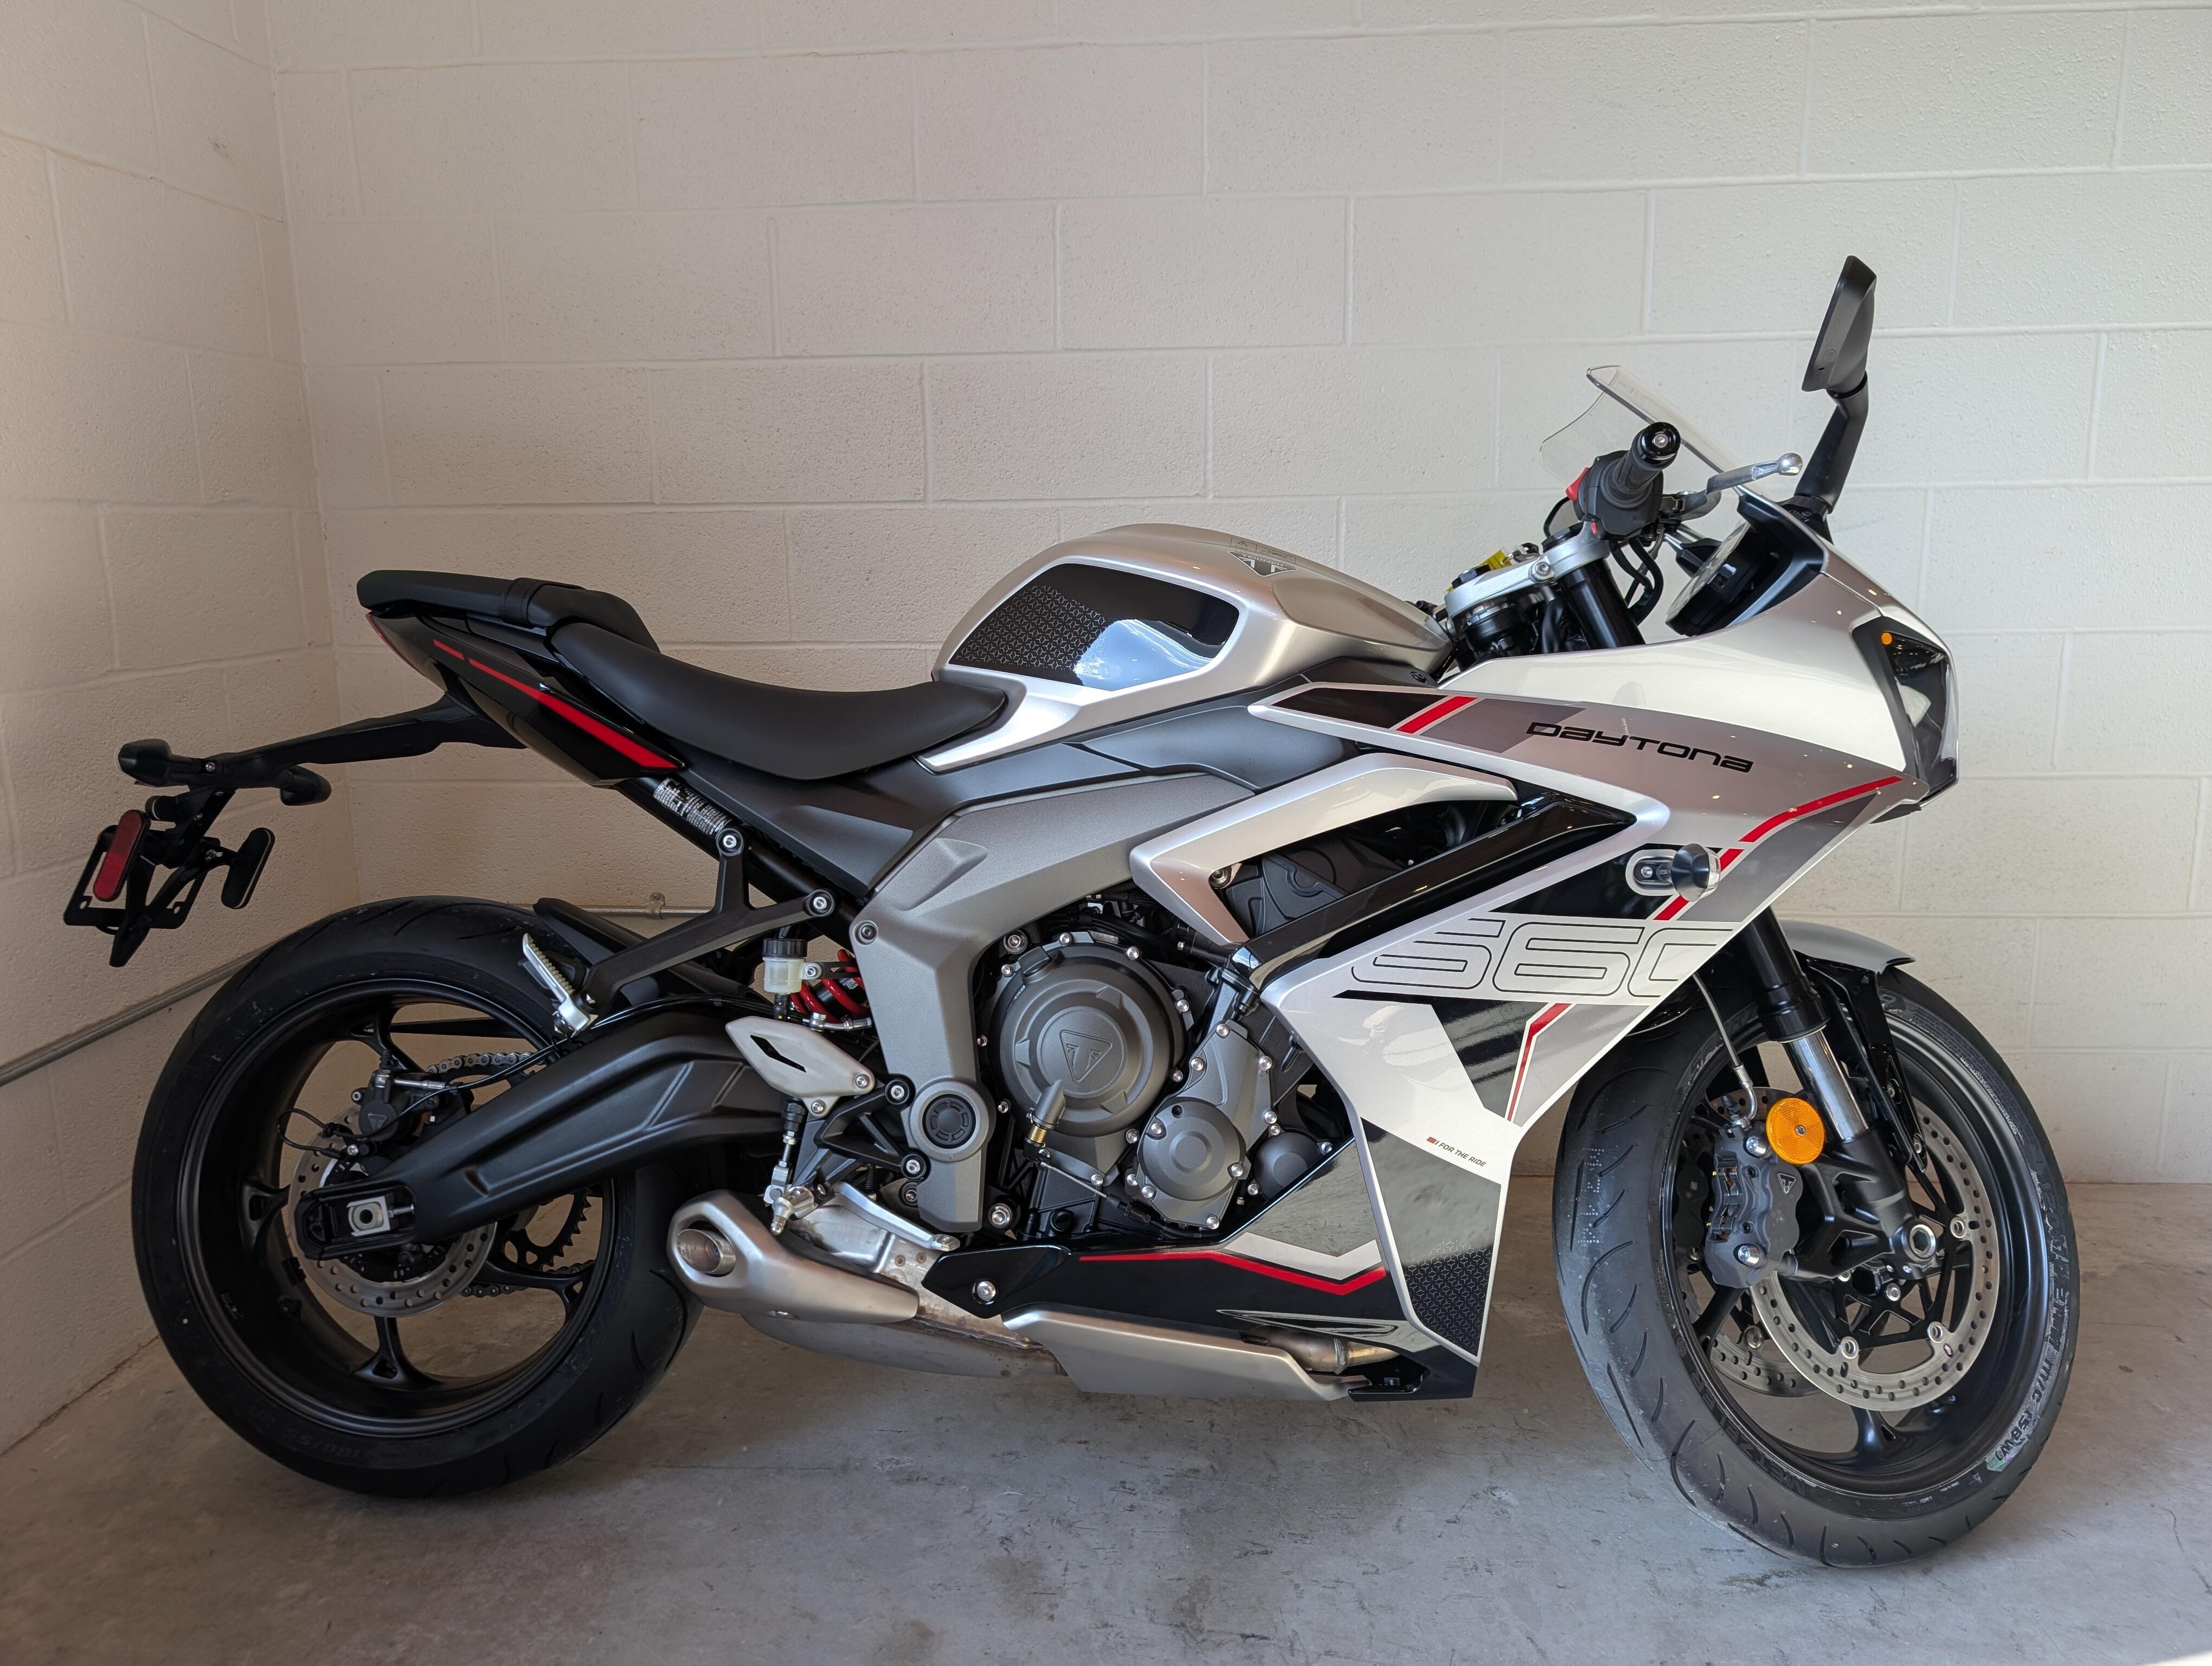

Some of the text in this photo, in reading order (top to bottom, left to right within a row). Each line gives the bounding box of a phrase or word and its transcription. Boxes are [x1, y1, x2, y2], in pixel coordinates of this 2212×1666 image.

[1438, 1142, 1455, 1152] FOR
[1455, 1149, 1470, 1159] THE
[1468, 1156, 1487, 1167] RIDE
